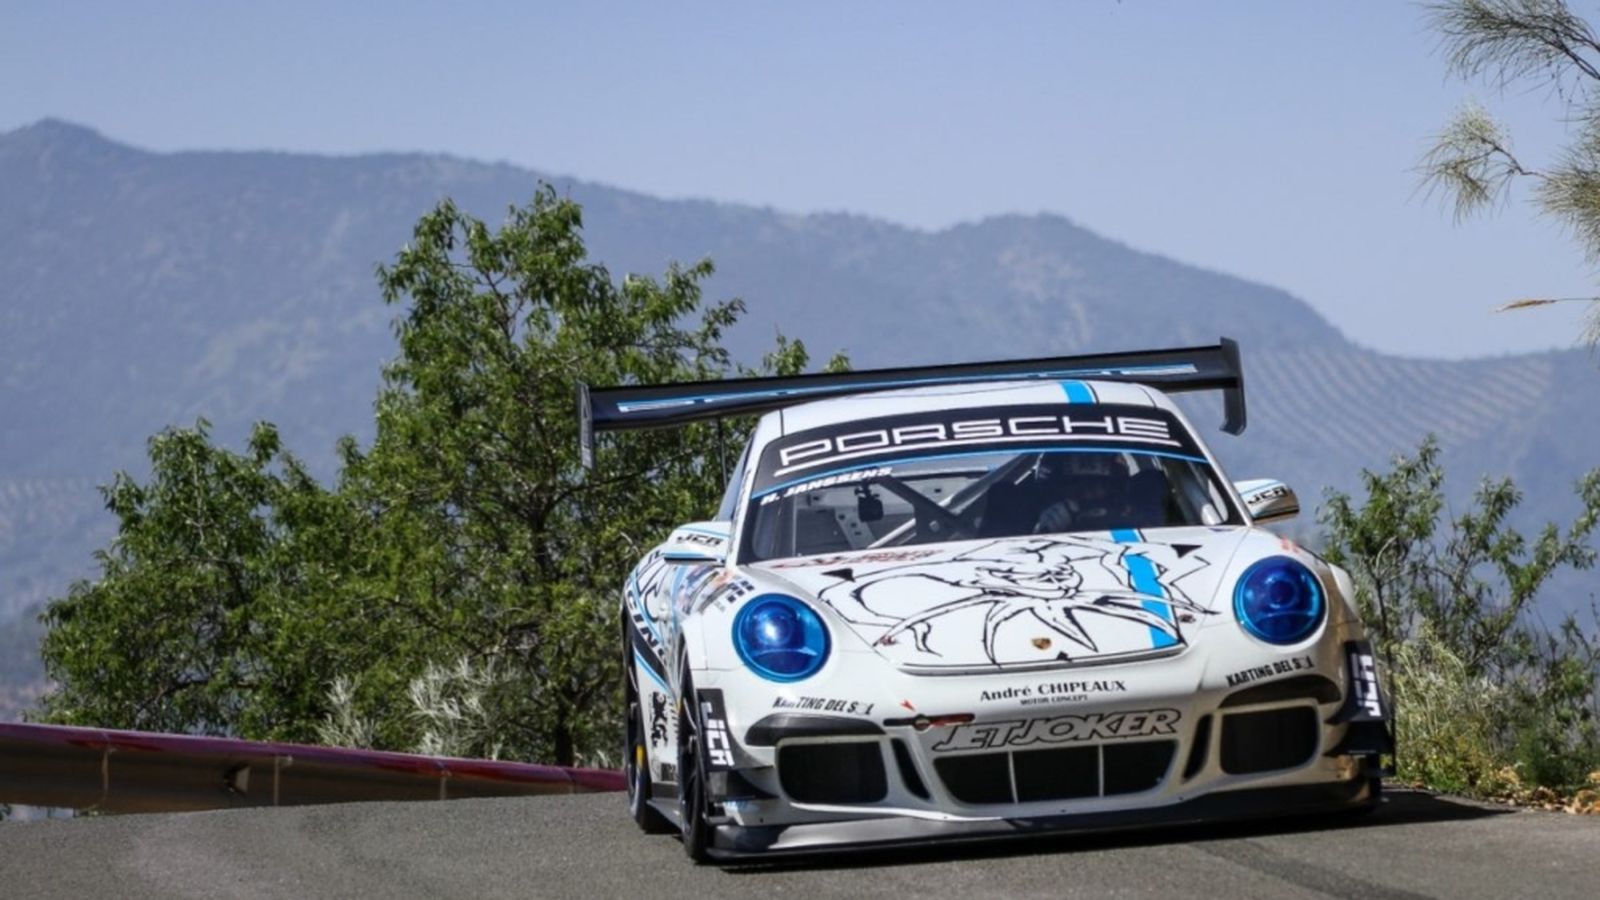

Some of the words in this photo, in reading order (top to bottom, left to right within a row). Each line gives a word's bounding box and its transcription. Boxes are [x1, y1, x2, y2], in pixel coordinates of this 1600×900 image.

[779, 416, 1171, 467] PORSCHE
[783, 467, 893, 498] JANSSENS
[1226, 663, 1273, 688] KARTING
[1272, 656, 1295, 674] DEL
[824, 699, 848, 712] DEL
[980, 686, 1032, 702] André
[1038, 680, 1127, 695] CHIPEAUX
